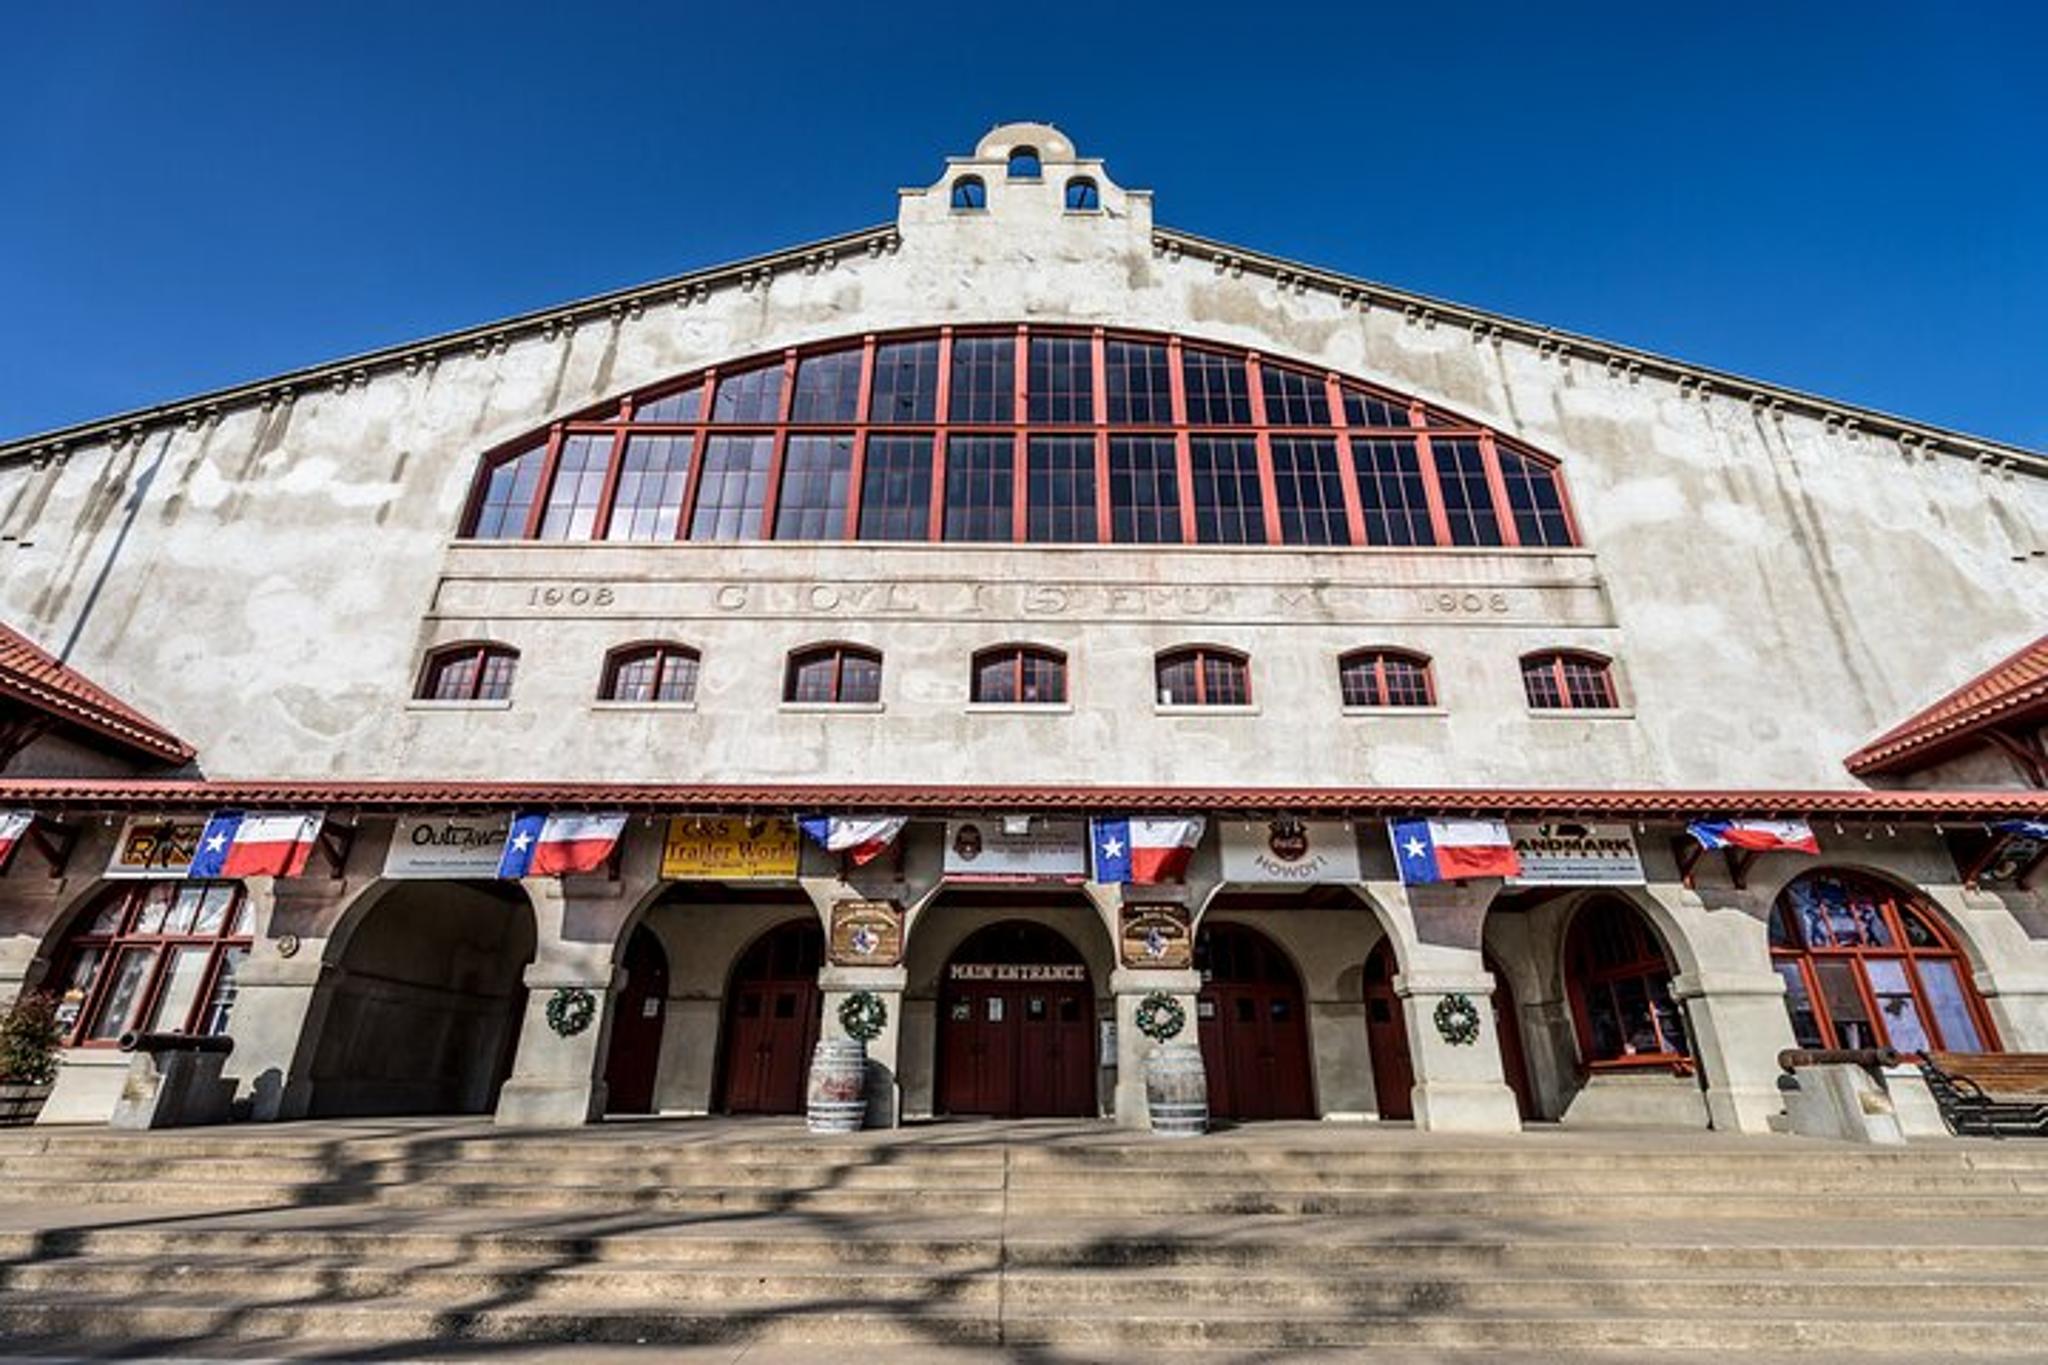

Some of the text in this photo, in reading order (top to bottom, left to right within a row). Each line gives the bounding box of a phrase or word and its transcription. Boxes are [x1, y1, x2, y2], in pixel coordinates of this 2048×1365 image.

[526, 586, 616, 607] 1908
[1422, 592, 1509, 613] 1908
[667, 840, 734, 861] Trailer
[1513, 838, 1634, 857] ANDMARK
[951, 963, 1086, 981] MAIN ENTRANCE
